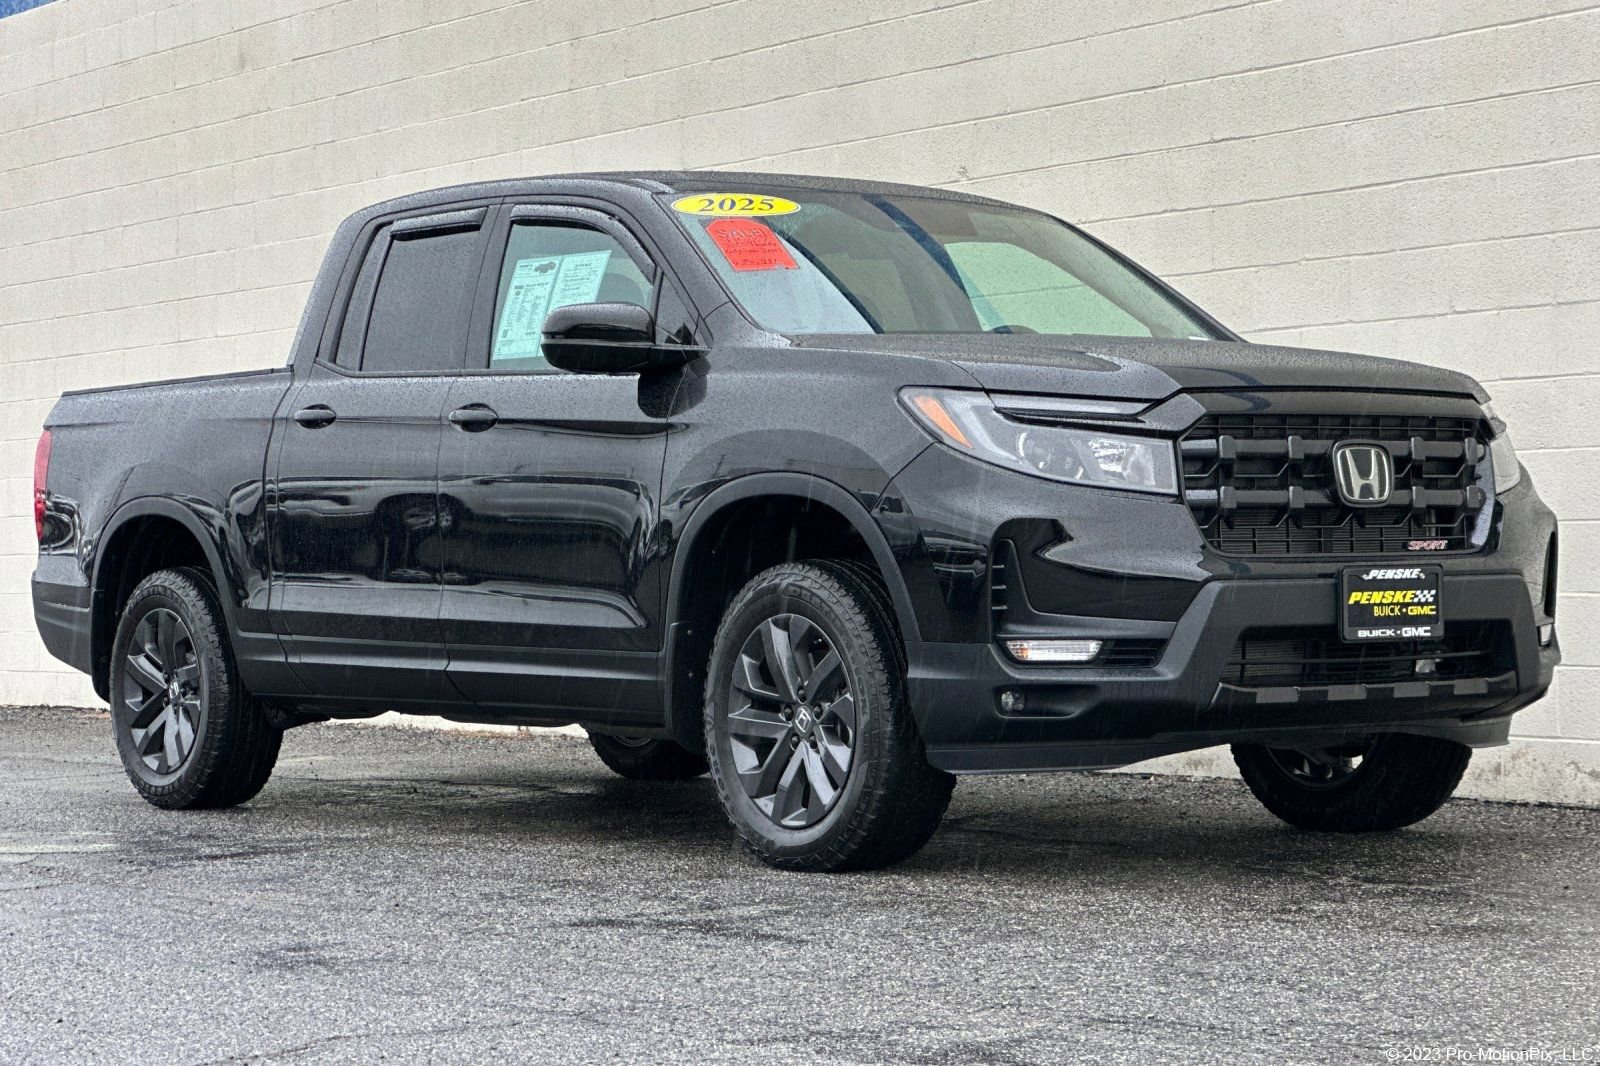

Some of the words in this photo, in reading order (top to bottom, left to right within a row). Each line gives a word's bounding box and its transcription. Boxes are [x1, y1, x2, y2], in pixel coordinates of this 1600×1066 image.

[698, 198, 774, 212] 2025
[1408, 540, 1448, 551] SPORT
[1368, 568, 1421, 580] PENSKE
[1348, 590, 1416, 605] PENSKE
[1373, 605, 1401, 617] BUICK
[1407, 605, 1437, 615] GMC
[1357, 629, 1395, 638] BUICK
[1402, 626, 1431, 637] GMC
